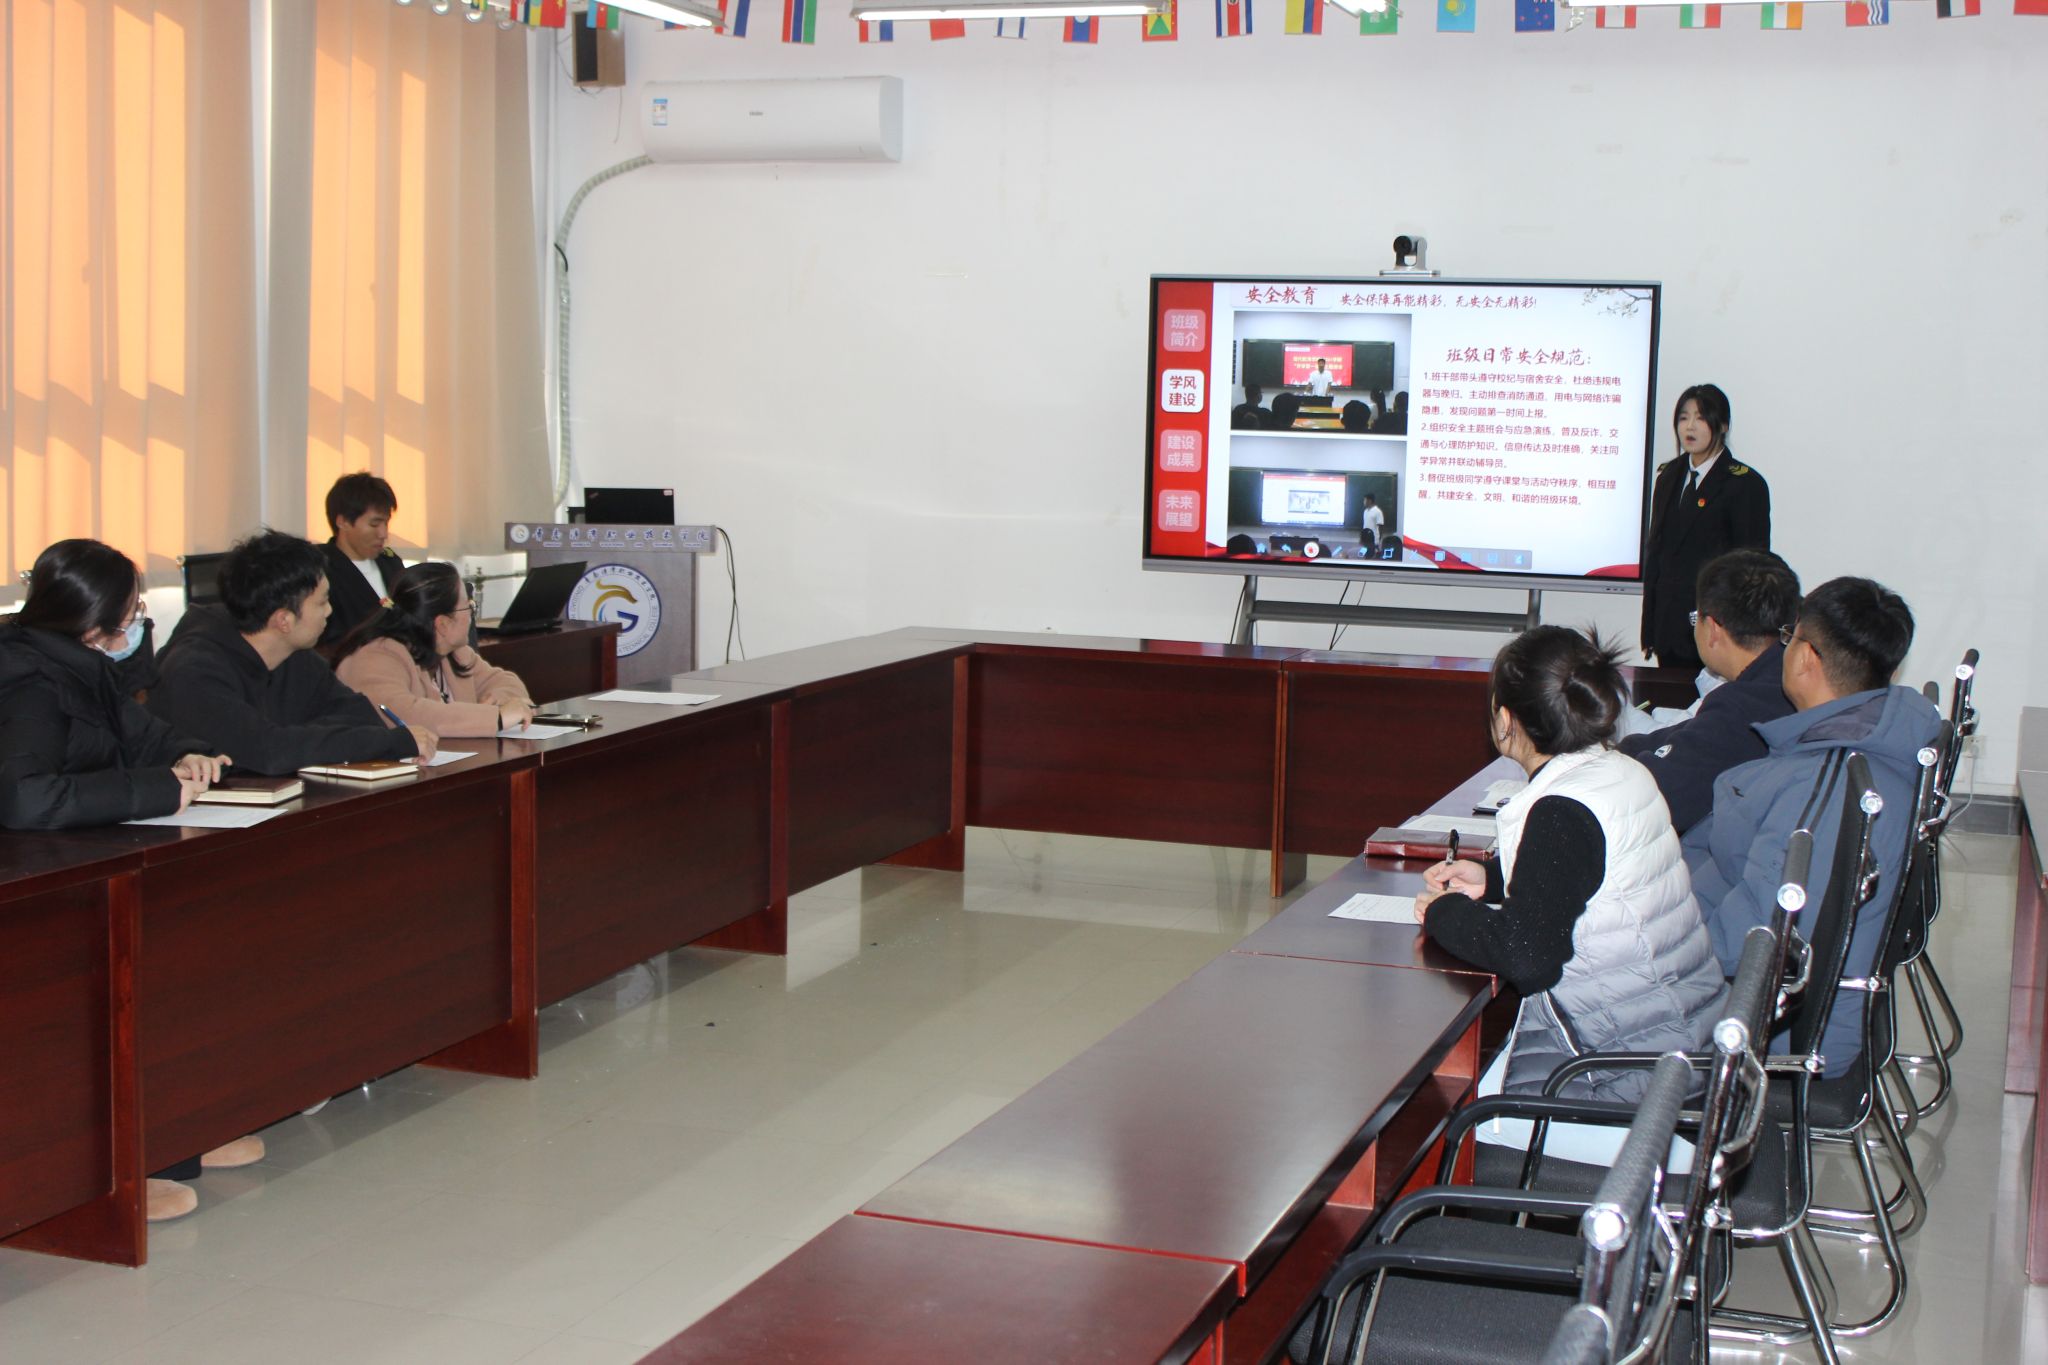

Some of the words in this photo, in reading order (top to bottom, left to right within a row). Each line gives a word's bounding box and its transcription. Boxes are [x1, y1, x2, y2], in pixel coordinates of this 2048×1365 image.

[1245, 285, 1318, 305] 安全教育
[1171, 315, 1198, 329] 班级
[1170, 332, 1198, 347] 简介
[1169, 375, 1197, 390] 学风
[1169, 392, 1196, 407] 建设
[1167, 435, 1195, 450] 建设
[1167, 453, 1195, 467] 成果
[1165, 496, 1193, 509] 未来
[1165, 512, 1193, 527] 展望
